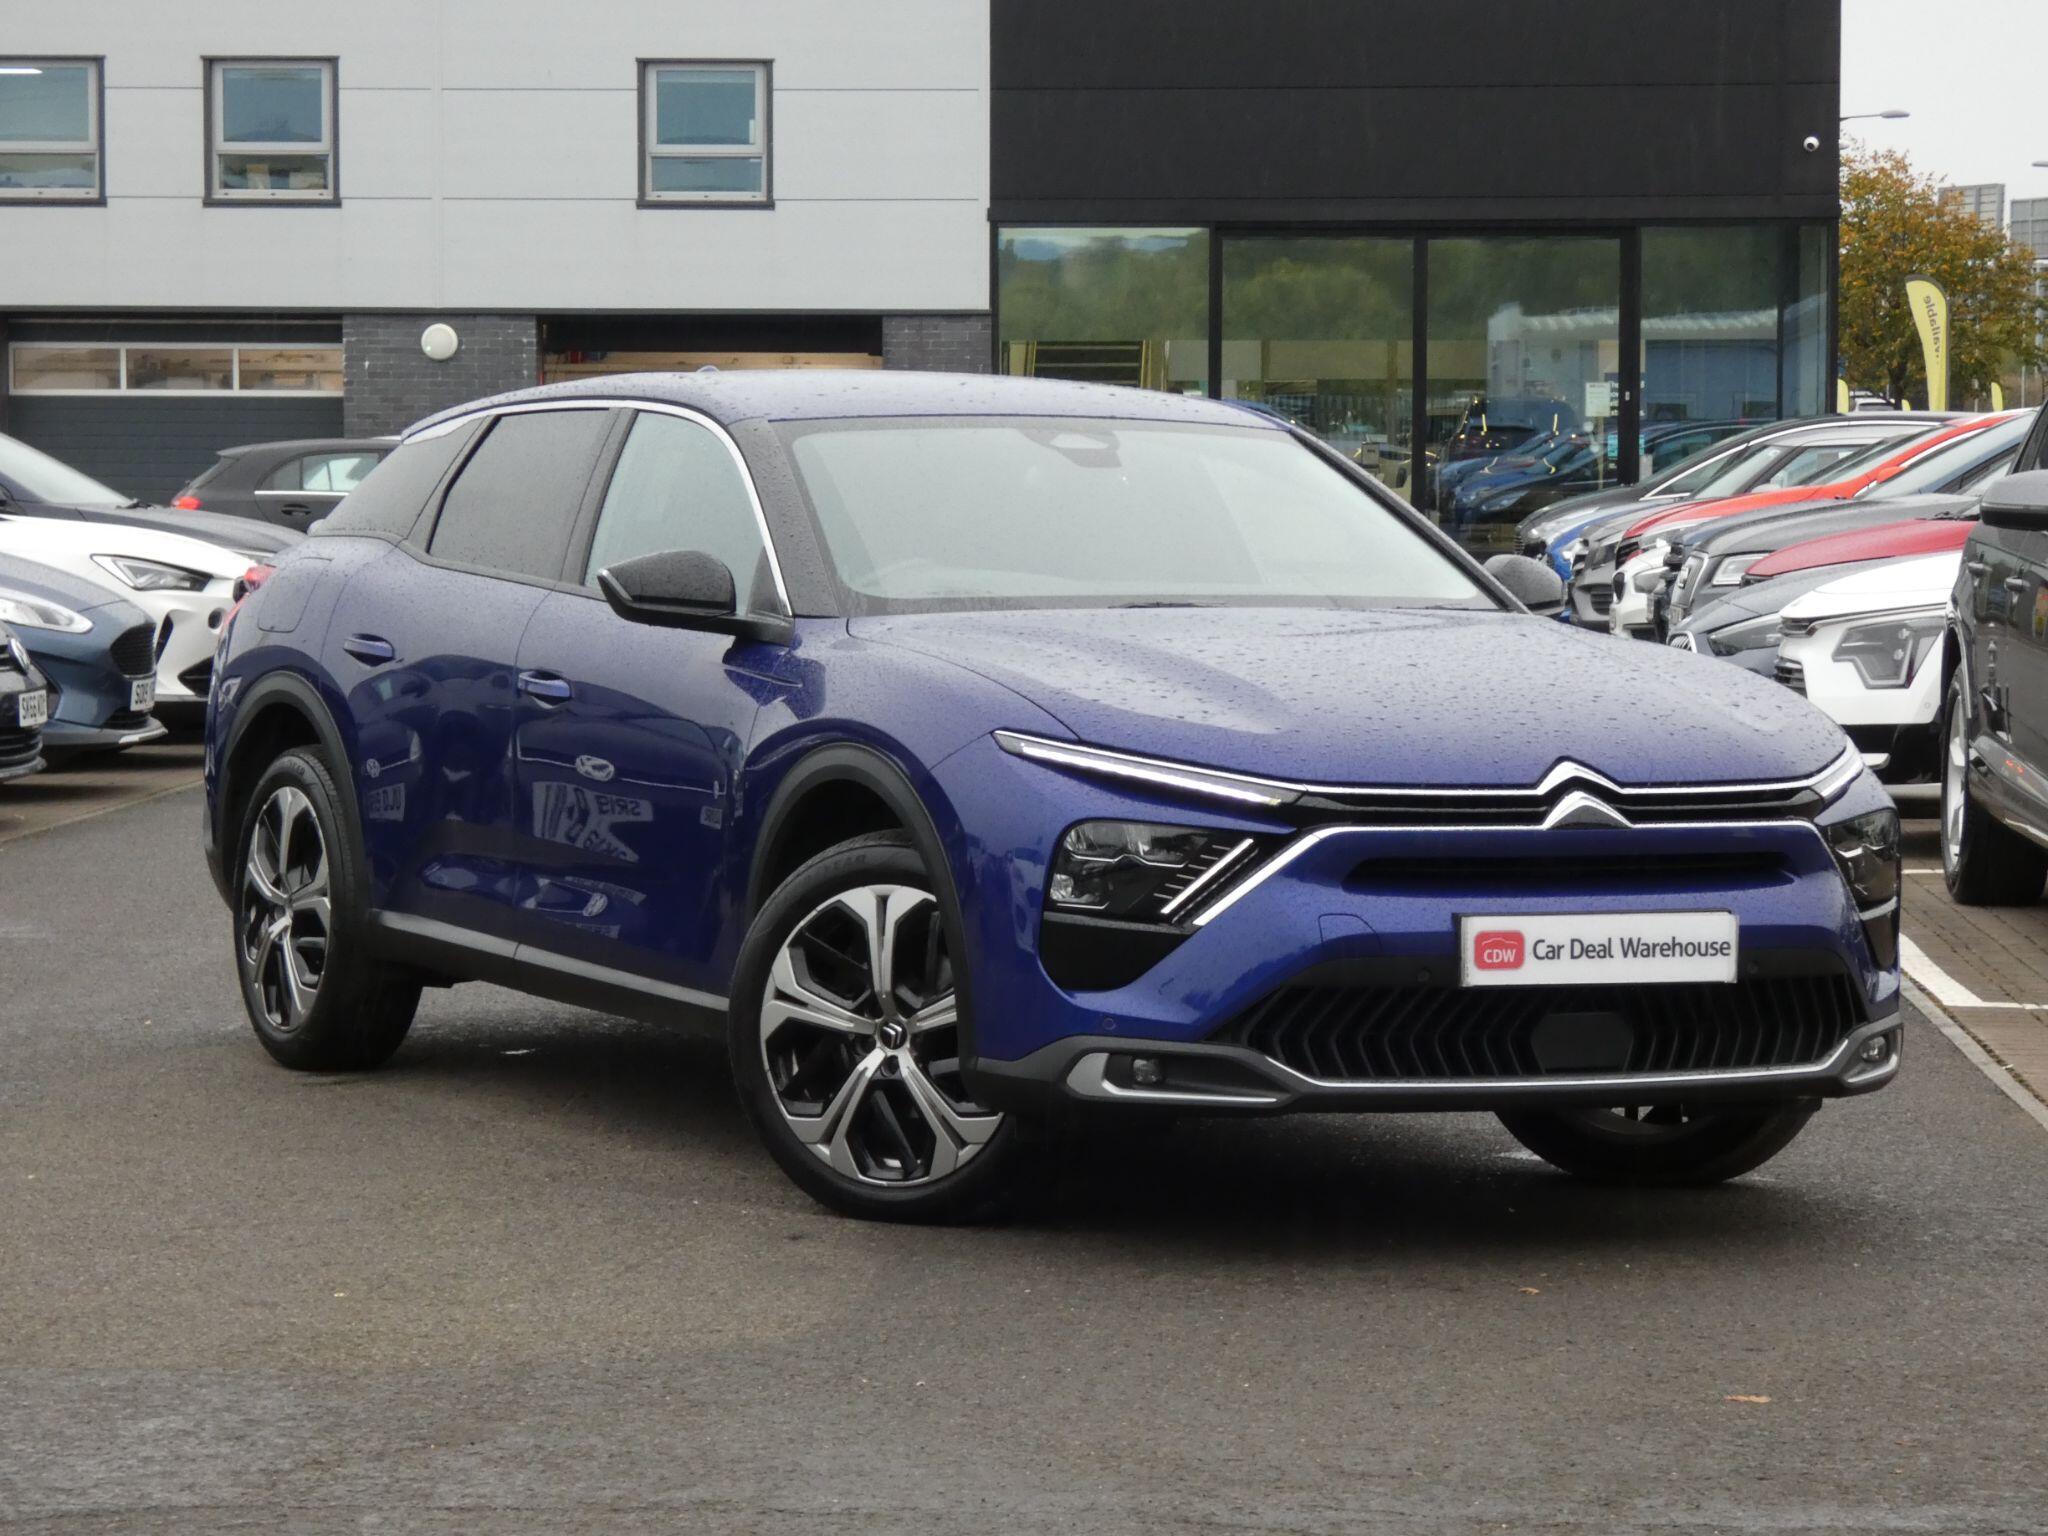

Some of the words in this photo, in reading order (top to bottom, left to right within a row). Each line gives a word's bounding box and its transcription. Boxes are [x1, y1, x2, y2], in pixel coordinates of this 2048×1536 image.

[1483, 948, 1516, 964] CDW
[1532, 939, 1564, 961] Car
[1570, 937, 1614, 959] Deal
[1620, 936, 1731, 958] Warehouse
